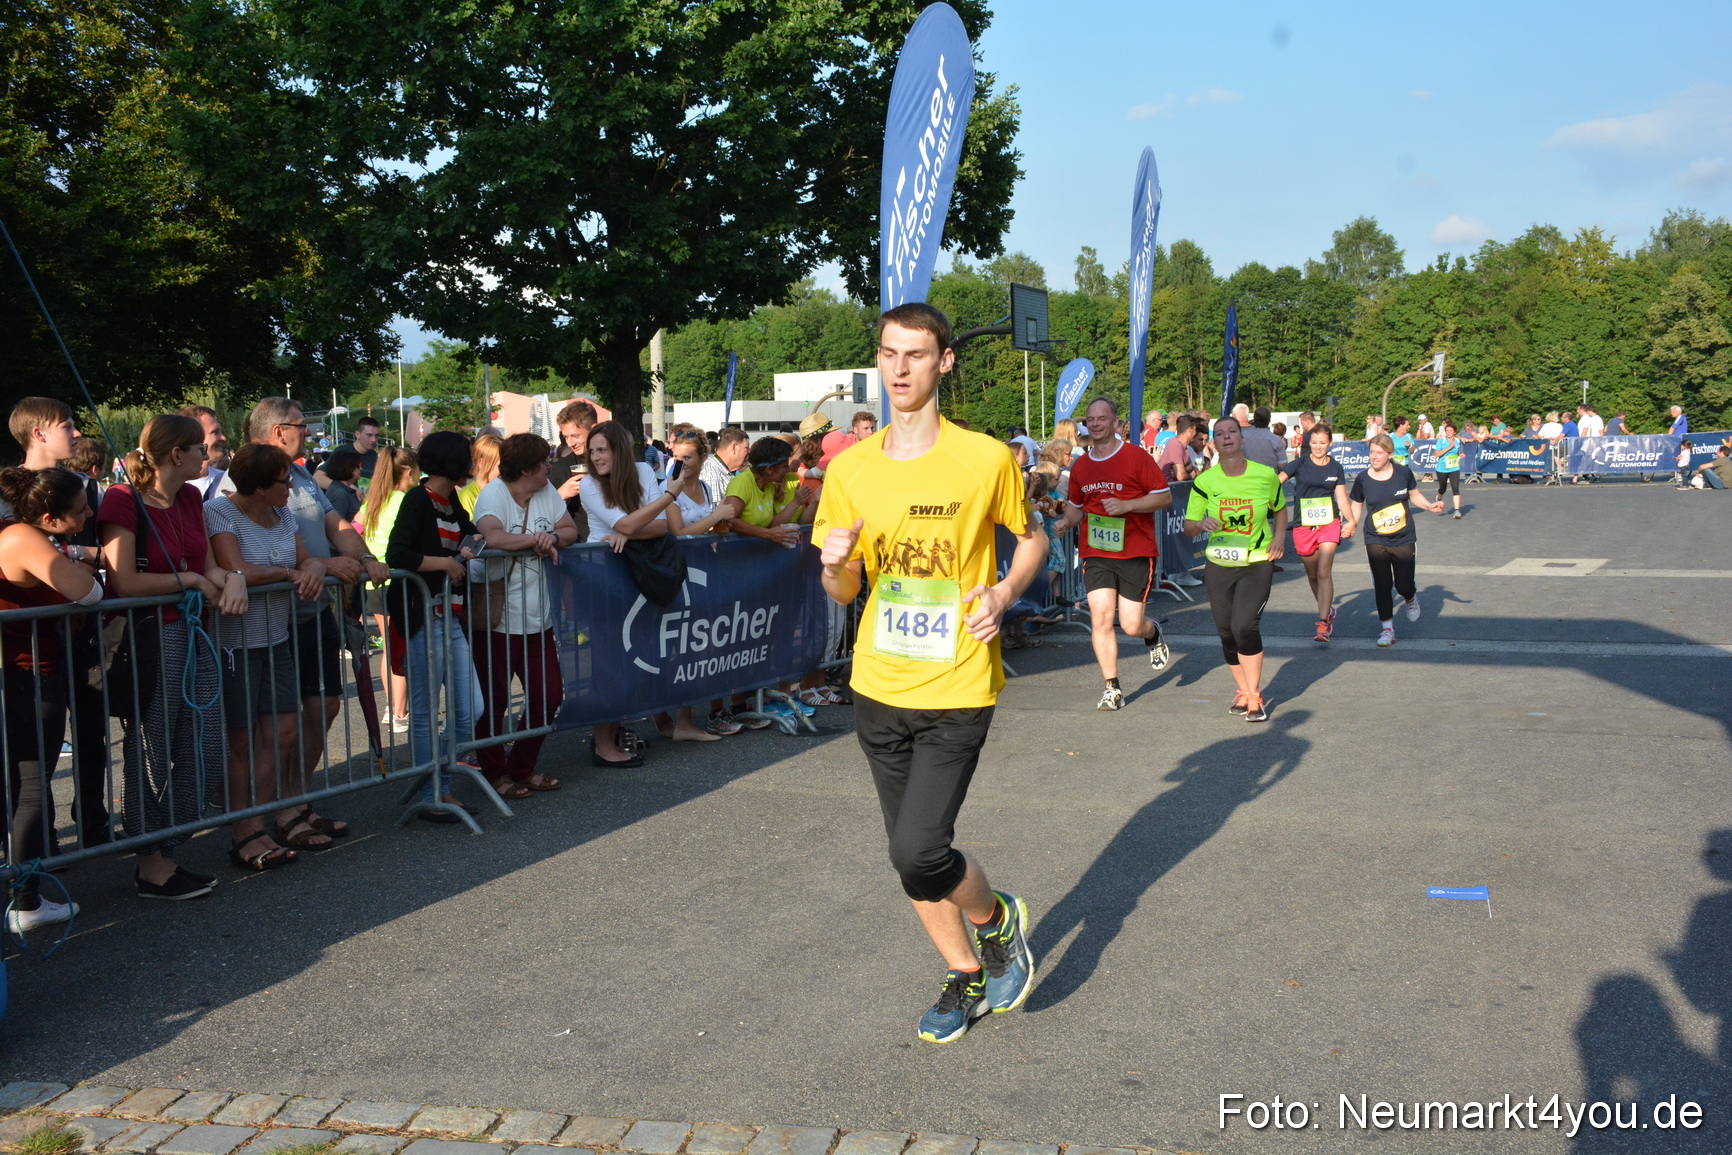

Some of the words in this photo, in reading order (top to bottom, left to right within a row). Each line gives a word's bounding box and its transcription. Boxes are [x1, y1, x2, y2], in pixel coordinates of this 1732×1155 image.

[895, 54, 948, 288] Fischer
[909, 92, 956, 283] AUTOMOBILE
[1064, 366, 1087, 405] Fischer
[1334, 453, 1370, 464] Fische
[1480, 449, 1530, 460] Frischmann
[1604, 450, 1663, 461] Fischer
[1219, 498, 1252, 506] Müller
[909, 505, 944, 516] swn
[1307, 508, 1327, 519] 685
[1228, 514, 1247, 527] M
[1381, 515, 1401, 528] 725
[1092, 528, 1120, 543] 1418
[1214, 549, 1239, 562] 339
[660, 600, 779, 658] Fischer
[884, 607, 949, 639] 1484
[673, 644, 769, 684] AUTOMOBILE
